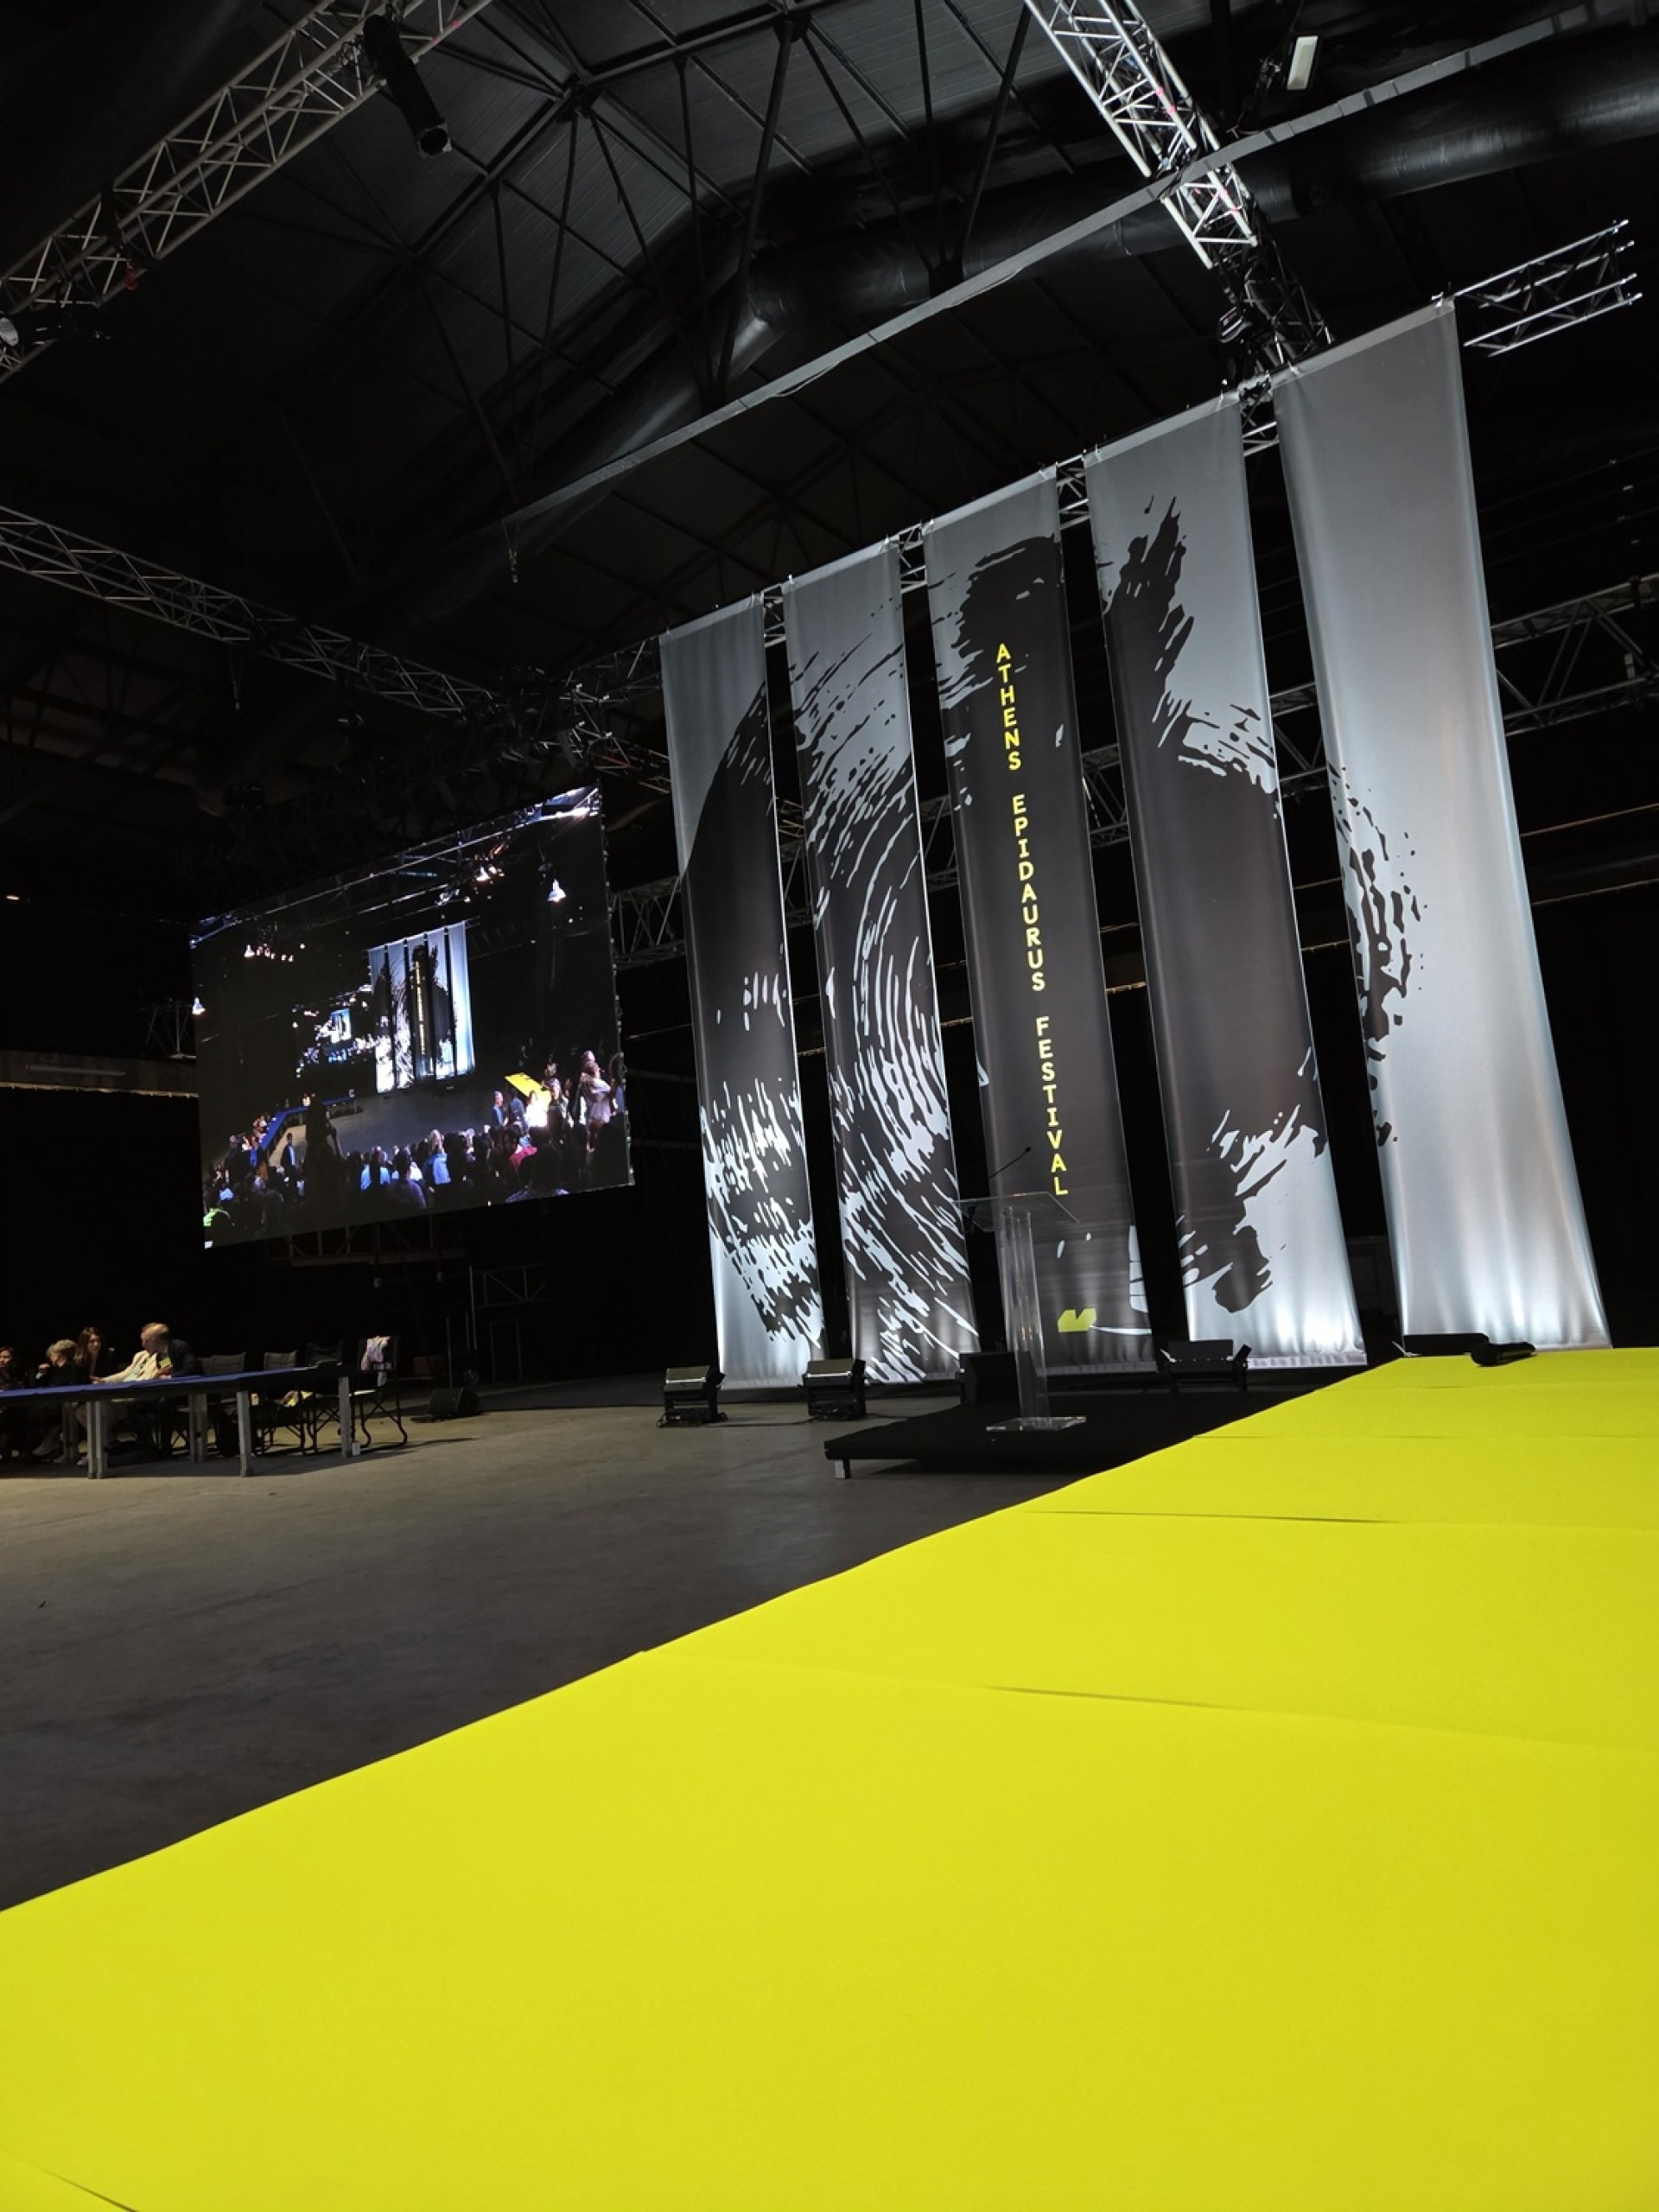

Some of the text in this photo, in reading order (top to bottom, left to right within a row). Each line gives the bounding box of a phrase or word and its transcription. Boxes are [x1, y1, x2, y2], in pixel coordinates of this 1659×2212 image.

[996, 643, 1068, 1196] ATHENS EPIDAURUS FESTIVAL
